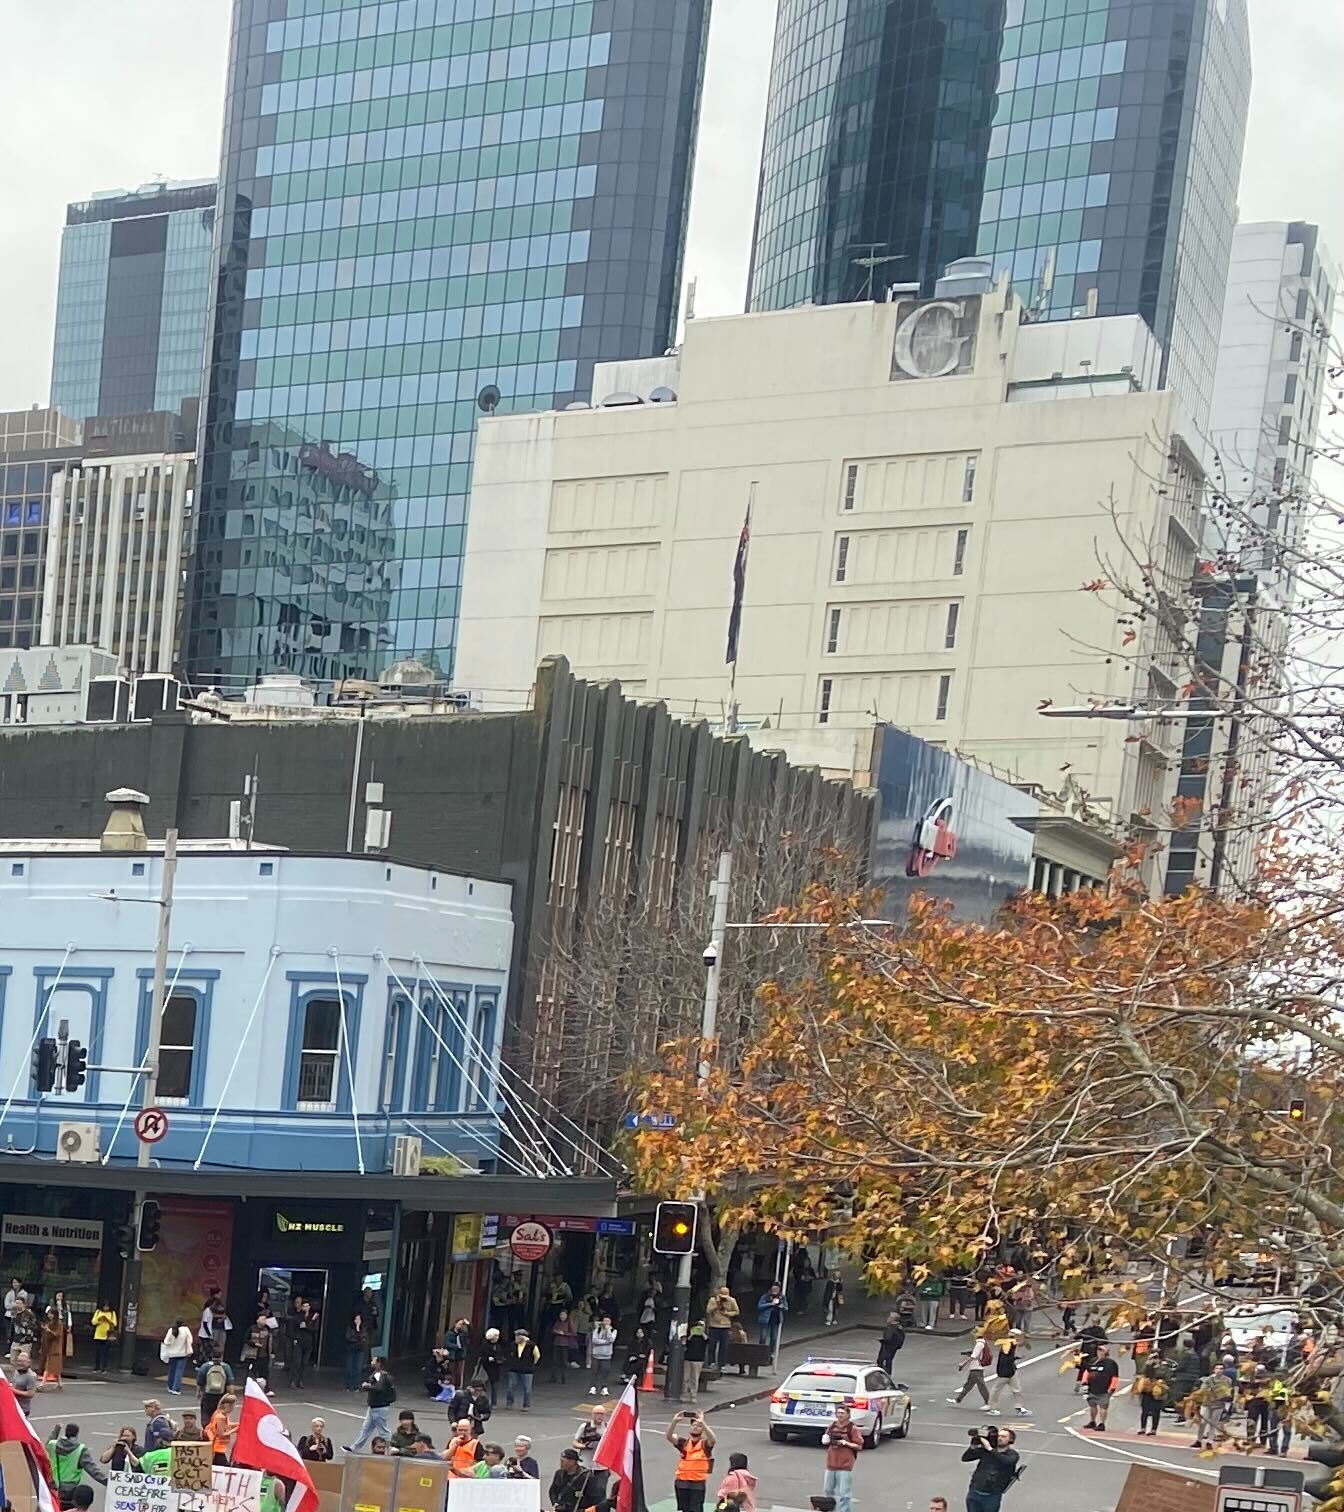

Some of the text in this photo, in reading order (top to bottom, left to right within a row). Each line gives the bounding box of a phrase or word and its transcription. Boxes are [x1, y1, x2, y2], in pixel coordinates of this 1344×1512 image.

[895, 301, 969, 378] G
[5, 1222, 100, 1241] Health & Nutrition
[288, 1222, 344, 1232] NZ MUSCLE
[799, 1408, 832, 1417] POLICE
[175, 1445, 202, 1457] FAST
[174, 1457, 209, 1468] TRACK
[110, 1472, 122, 1482] WE
[173, 1468, 202, 1480] GET
[174, 1479, 210, 1491] BACK
[114, 1485, 169, 1501] CEASEFIRE
